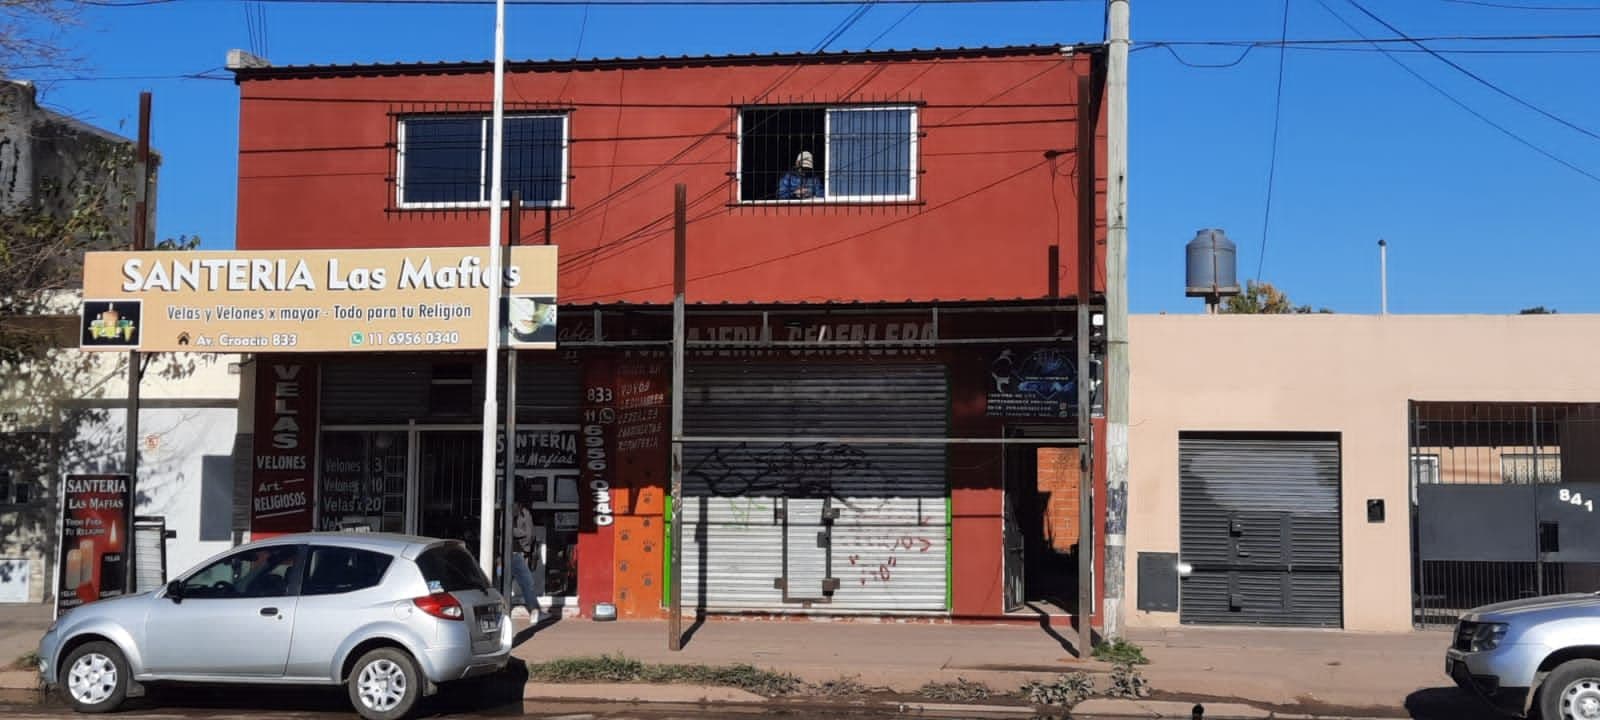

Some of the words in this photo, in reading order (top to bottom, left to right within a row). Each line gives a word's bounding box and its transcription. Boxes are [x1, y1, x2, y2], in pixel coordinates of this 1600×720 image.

[122, 257, 316, 292] SANTERIA
[328, 256, 387, 291] Las
[168, 305, 200, 320] Velas
[205, 309, 213, 322] y
[217, 305, 264, 320] Velones
[269, 308, 276, 319] x
[280, 307, 319, 322] mayor
[335, 305, 363, 319] Todo
[367, 306, 396, 321] para
[402, 305, 414, 318] tu
[272, 334, 298, 346] 833
[368, 333, 383, 345] 11
[388, 333, 421, 345] 6956
[425, 333, 459, 345] 0340
[587, 387, 612, 403] 833
[272, 364, 302, 448] VELAS
[584, 408, 596, 422] 11
[496, 432, 577, 453] SNTERIA
[257, 456, 306, 470] VELONES
[67, 479, 126, 493] SANTERIA
[255, 492, 306, 513] RELIGIOSOS
[1560, 488, 1593, 512] 841
